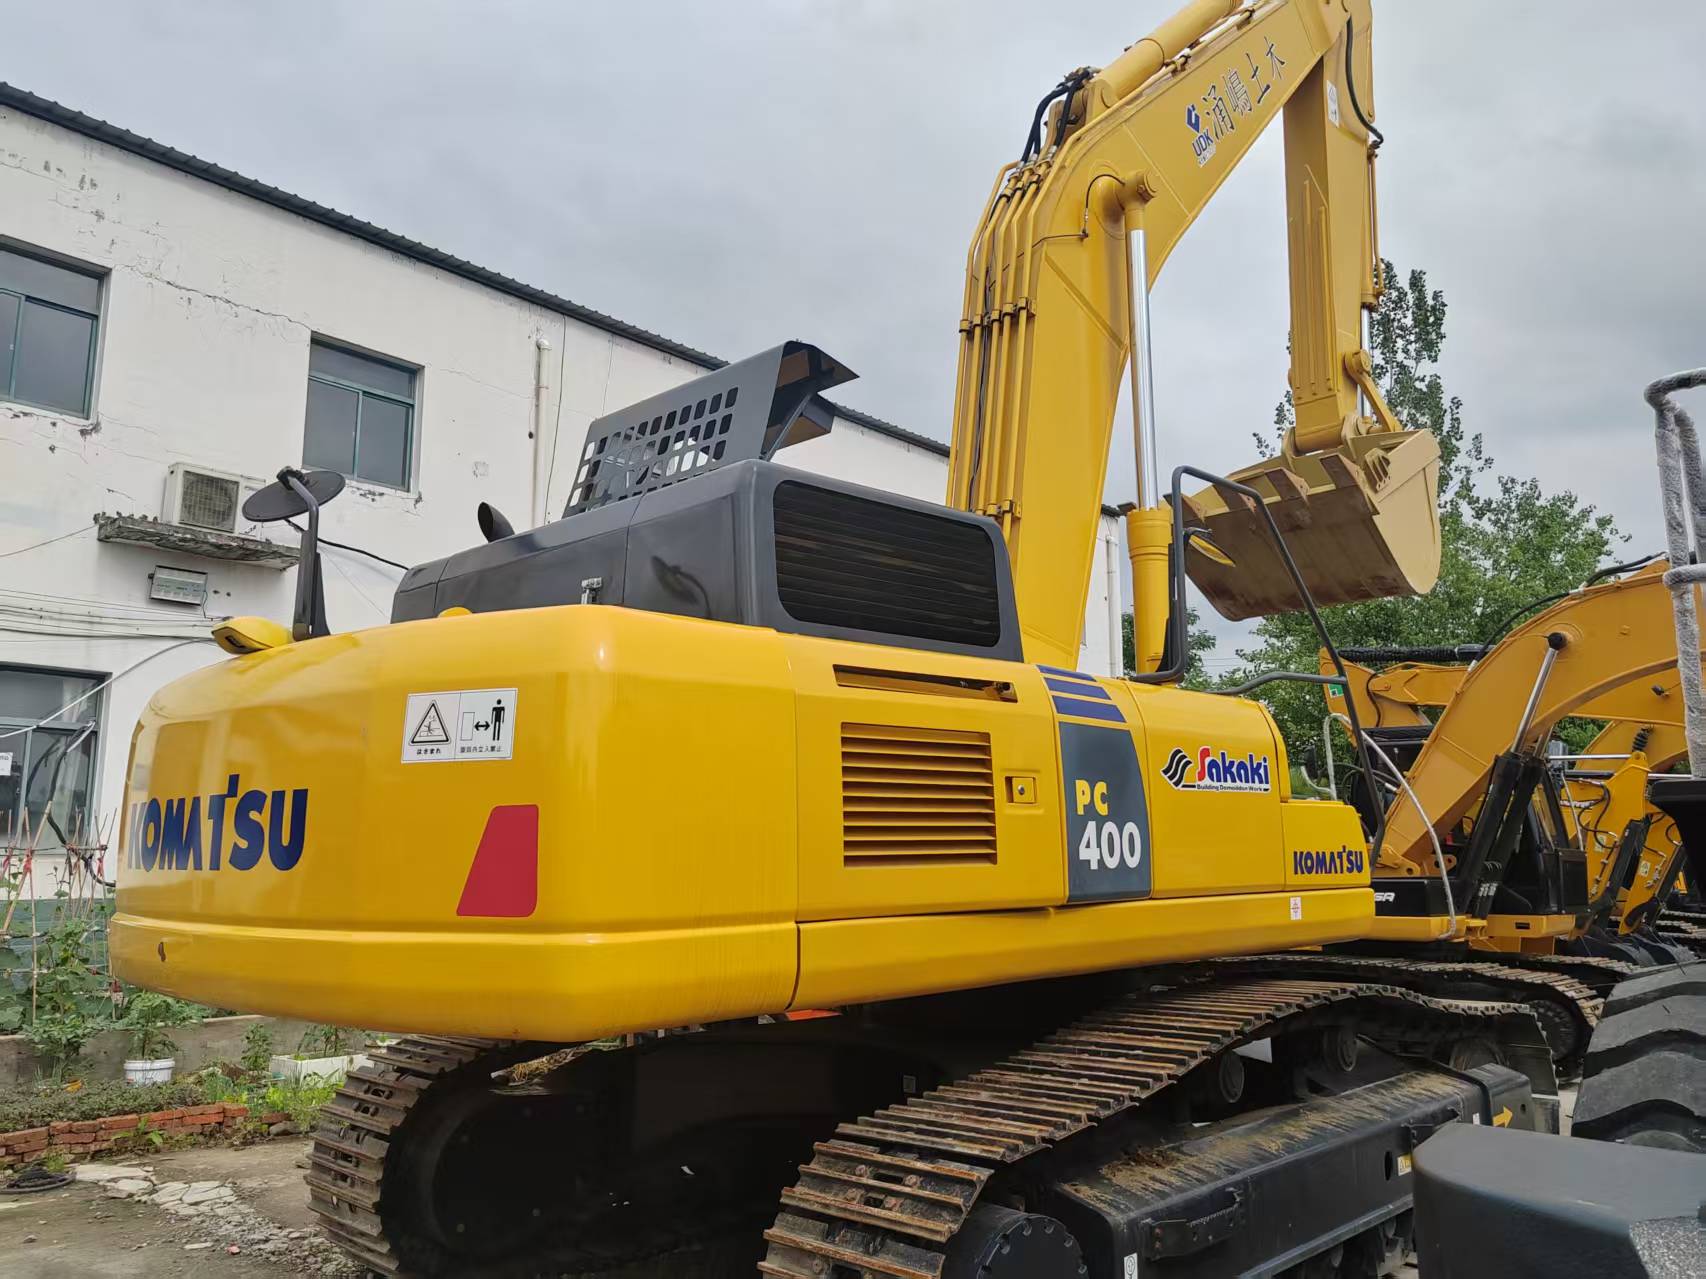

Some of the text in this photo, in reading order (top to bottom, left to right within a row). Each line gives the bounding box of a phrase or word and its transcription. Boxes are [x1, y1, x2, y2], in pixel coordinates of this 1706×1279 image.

[1192, 129, 1213, 156] UDK
[1197, 748, 1269, 785] Sakaki
[1075, 779, 1108, 816] PC
[127, 774, 308, 872] KOMATSU
[1078, 820, 1141, 870] 400
[1293, 845, 1364, 875] KOMATSU
